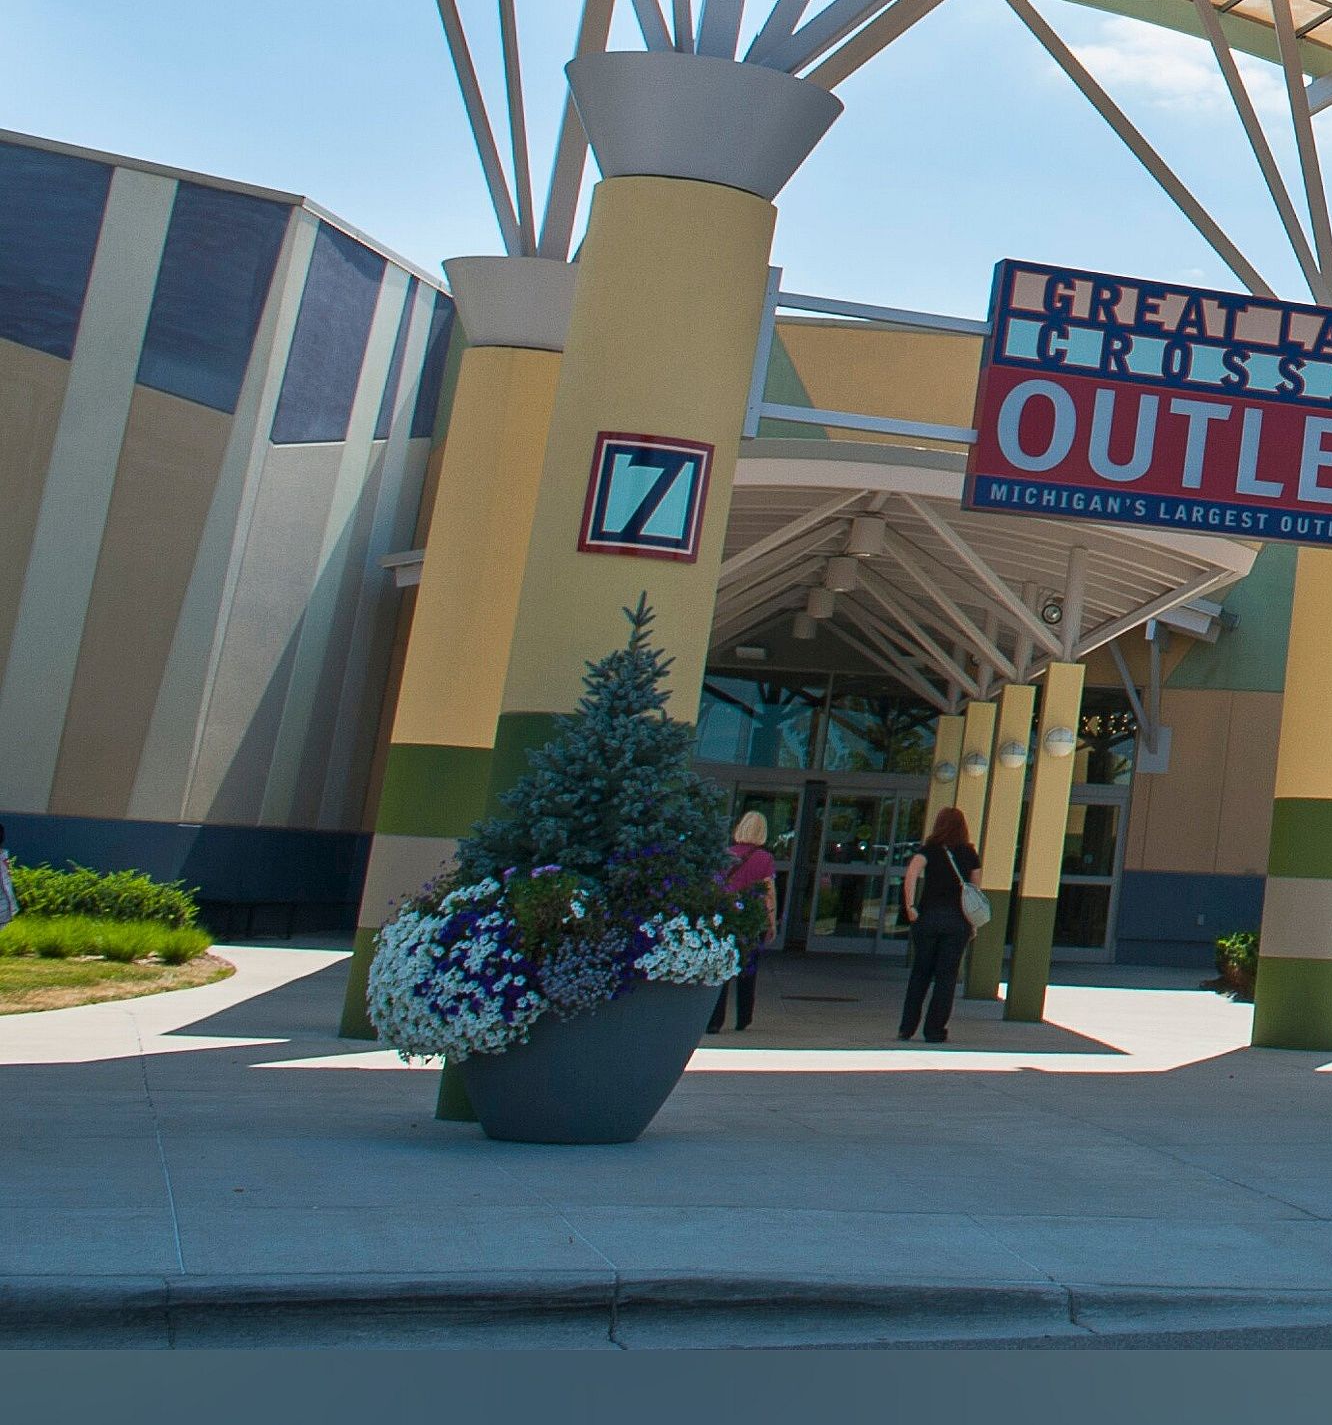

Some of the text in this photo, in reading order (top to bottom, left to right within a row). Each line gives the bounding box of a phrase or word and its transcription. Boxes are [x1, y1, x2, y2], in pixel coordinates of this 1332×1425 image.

[1043, 274, 1249, 342] GREAT
[620, 453, 688, 536] 7
[990, 483, 1147, 516] MICHIGAN'S
[1159, 501, 1269, 531] LARGEST
